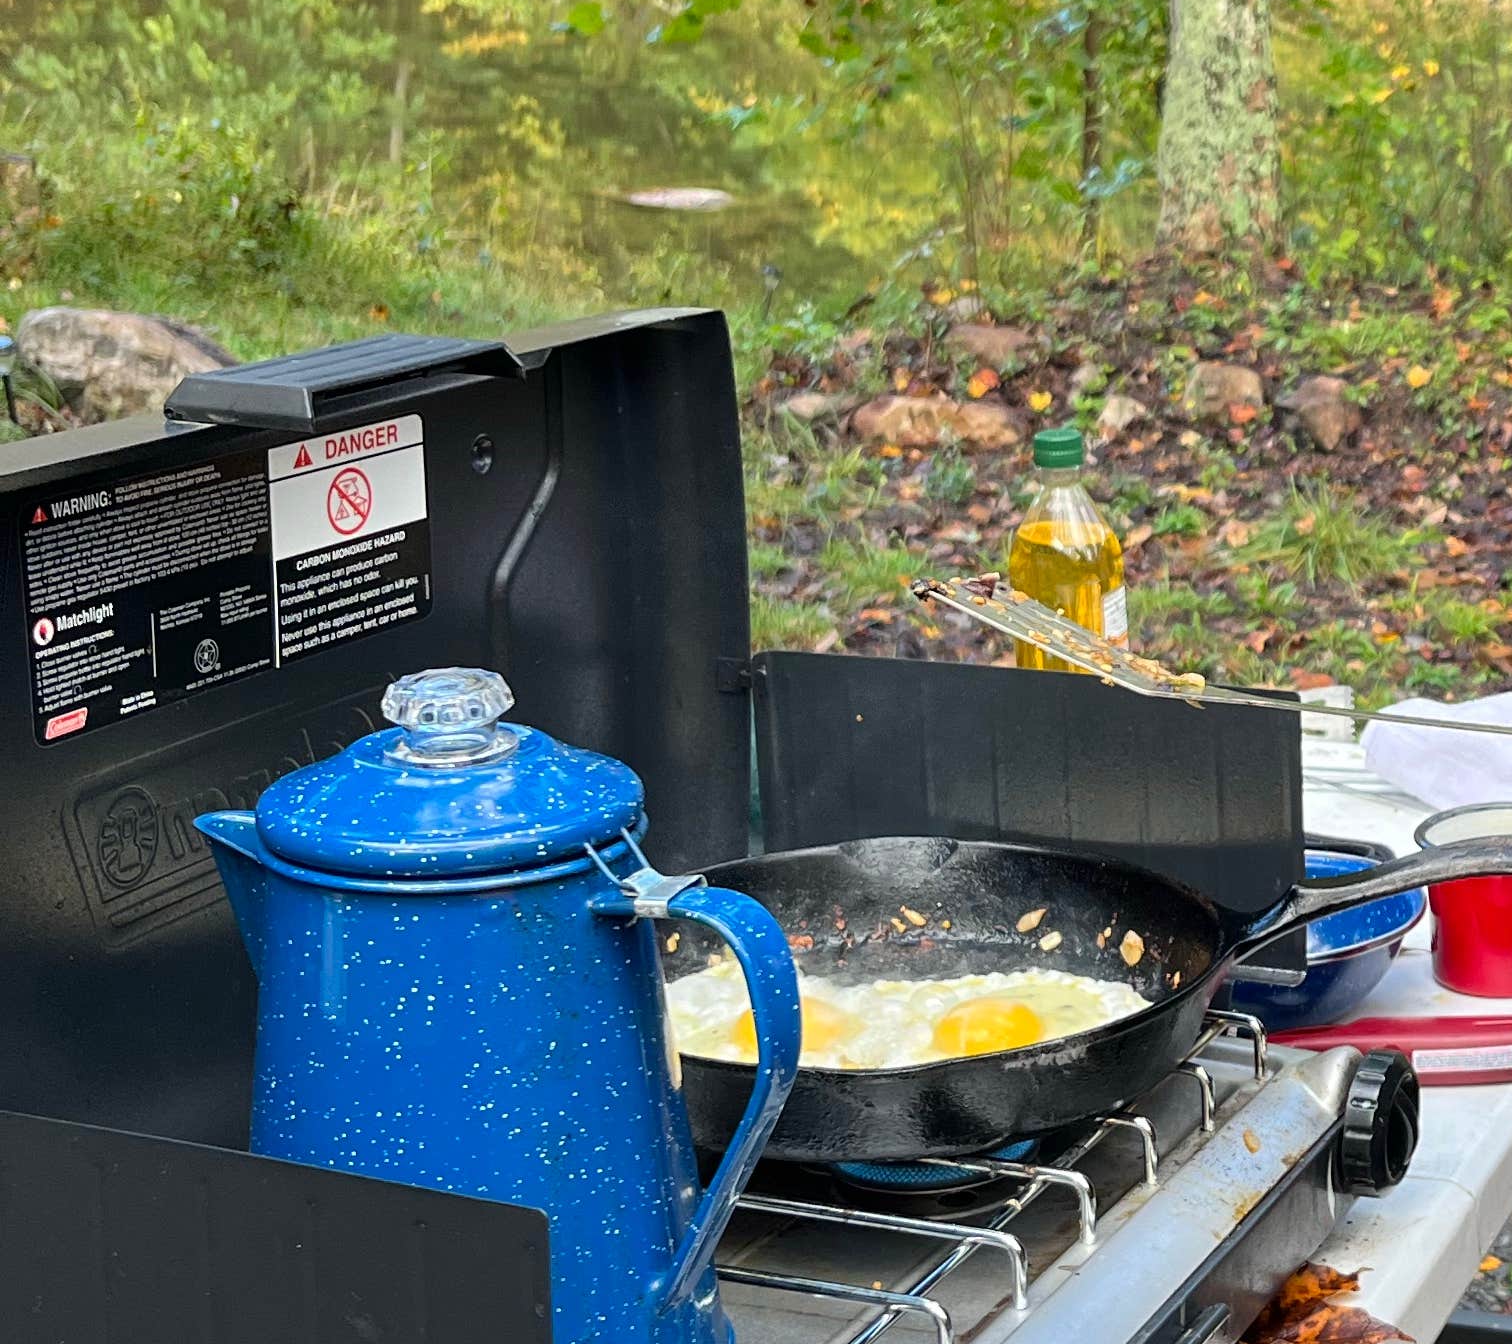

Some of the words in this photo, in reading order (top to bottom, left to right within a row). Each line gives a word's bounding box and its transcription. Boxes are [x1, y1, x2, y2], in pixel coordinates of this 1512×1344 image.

[325, 424, 398, 459] DANGER
[51, 491, 112, 519] WARNING:
[296, 554, 331, 571] CARBON
[332, 540, 373, 560] MONOXIDE
[374, 530, 406, 548] HAZARD
[280, 583, 296, 594] This
[297, 572, 330, 590] appliance
[332, 568, 345, 578] can
[346, 560, 374, 576] produce
[374, 552, 398, 566] carbon
[318, 583, 338, 596] which
[340, 579, 352, 589] has
[354, 576, 362, 586] no
[57, 602, 114, 632] Matchlight
[281, 612, 302, 626] Using
[303, 610, 308, 618] it
[309, 608, 316, 616] in
[318, 604, 327, 614] an
[328, 593, 360, 610] enclosed
[360, 588, 380, 602] space
[381, 584, 394, 594] can
[395, 578, 404, 590] kill
[282, 630, 302, 643] Never
[304, 626, 318, 636] use
[318, 620, 332, 631] this
[332, 610, 366, 628] appliance
[366, 607, 374, 616] in
[374, 604, 384, 614] an
[384, 592, 414, 610] enclosed
[304, 636, 320, 649] such
